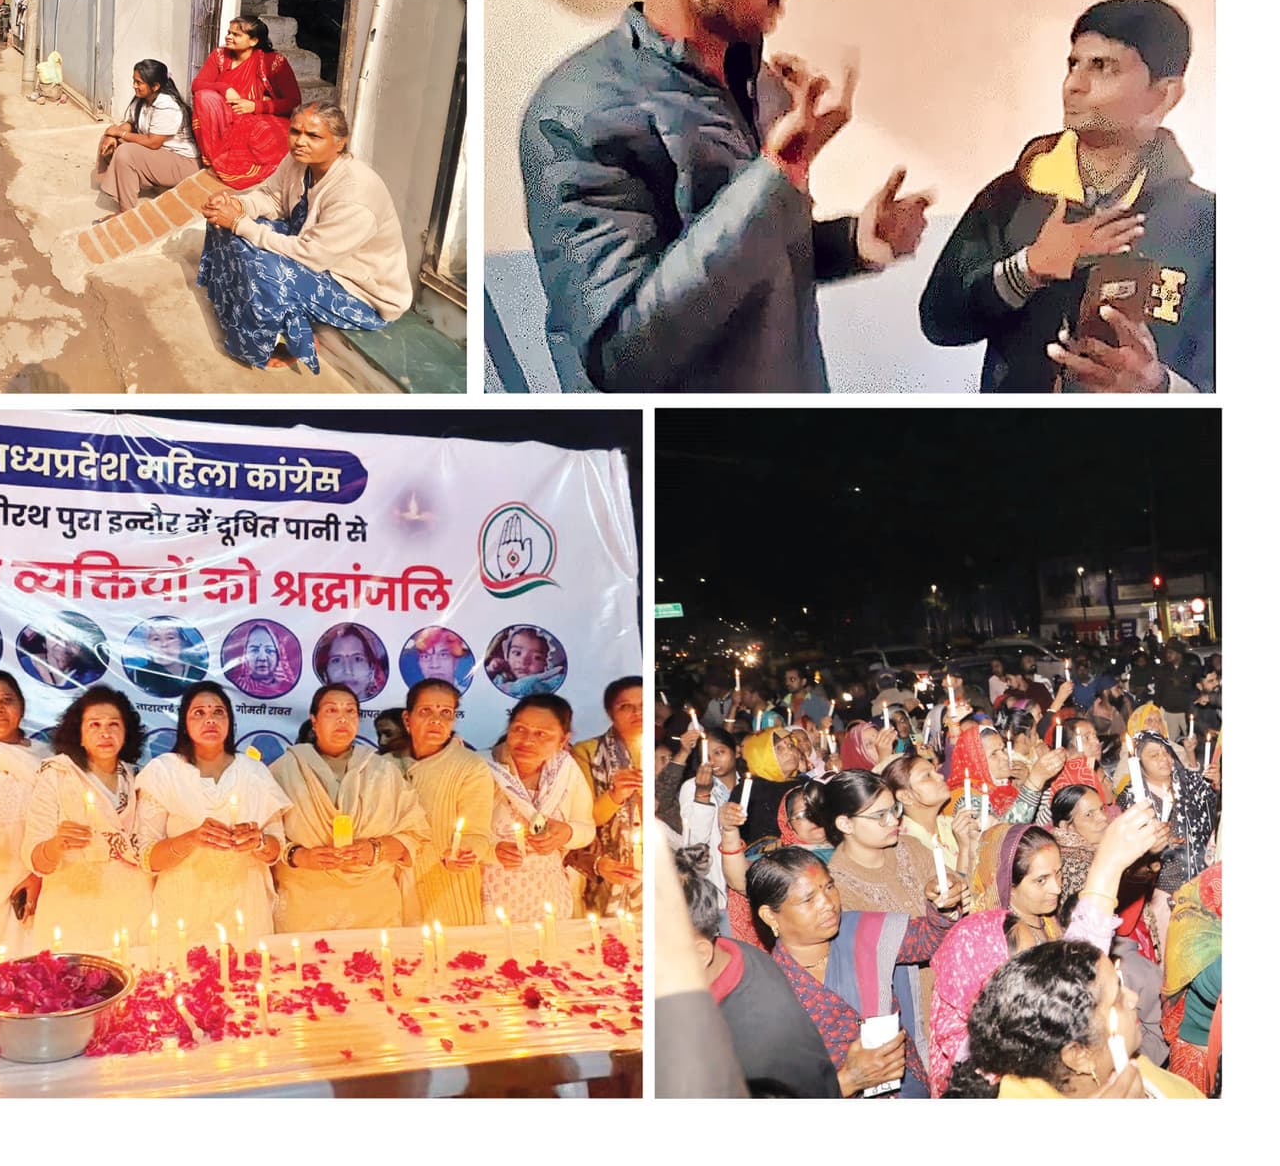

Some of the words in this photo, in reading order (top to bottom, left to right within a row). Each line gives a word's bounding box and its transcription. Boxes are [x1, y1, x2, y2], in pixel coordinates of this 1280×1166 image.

[137, 446, 238, 489] महिला
[245, 455, 341, 494] कांग्रेस
[58, 505, 102, 538] पुरा
[107, 502, 180, 535] इन्दौर
[185, 508, 213, 535] में
[216, 509, 277, 546] दूषित
[284, 512, 340, 542] पानी
[346, 514, 368, 542] से
[11, 549, 191, 602] व्यक्तियों
[199, 555, 262, 605] को
[271, 563, 453, 613] श्रद्धांजलि
[235, 702, 267, 715] गोमती
[267, 706, 292, 716] रावत
